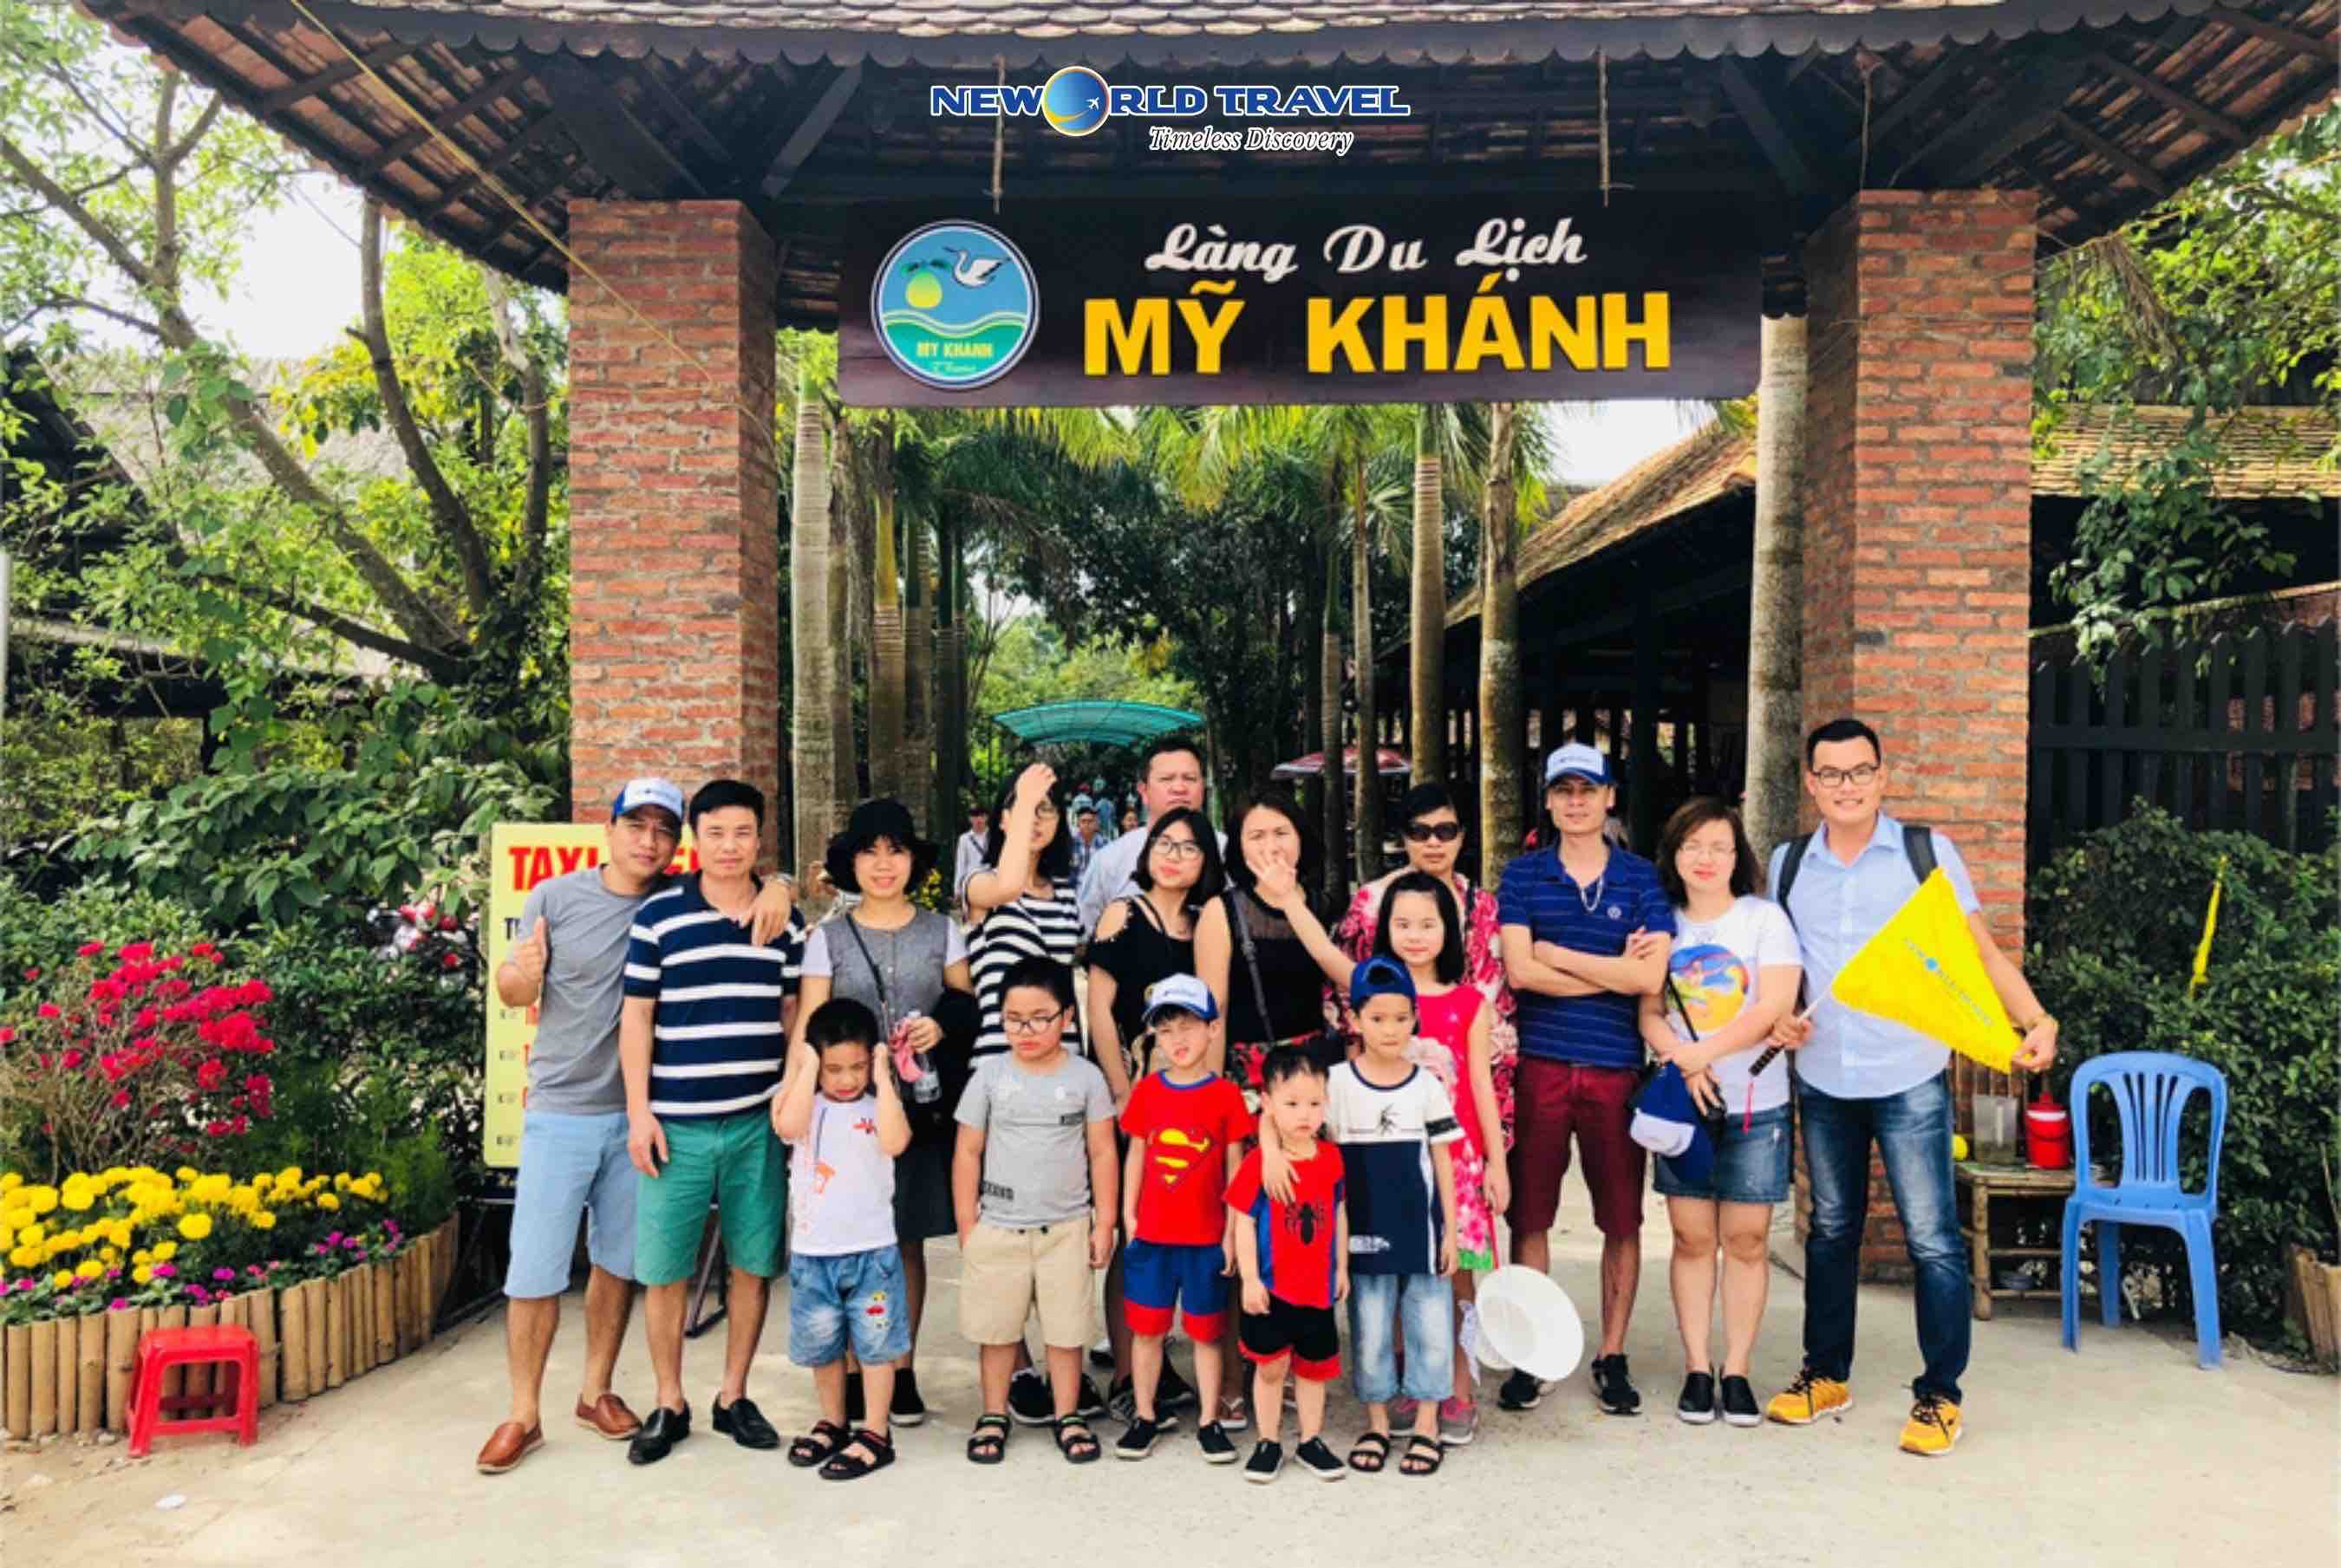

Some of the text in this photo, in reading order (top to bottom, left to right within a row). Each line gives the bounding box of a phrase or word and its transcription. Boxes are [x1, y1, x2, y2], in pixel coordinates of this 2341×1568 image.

[1144, 218, 1588, 283] Làng Du Lịch
[1084, 271, 1673, 376] MỸ KHÁNH
